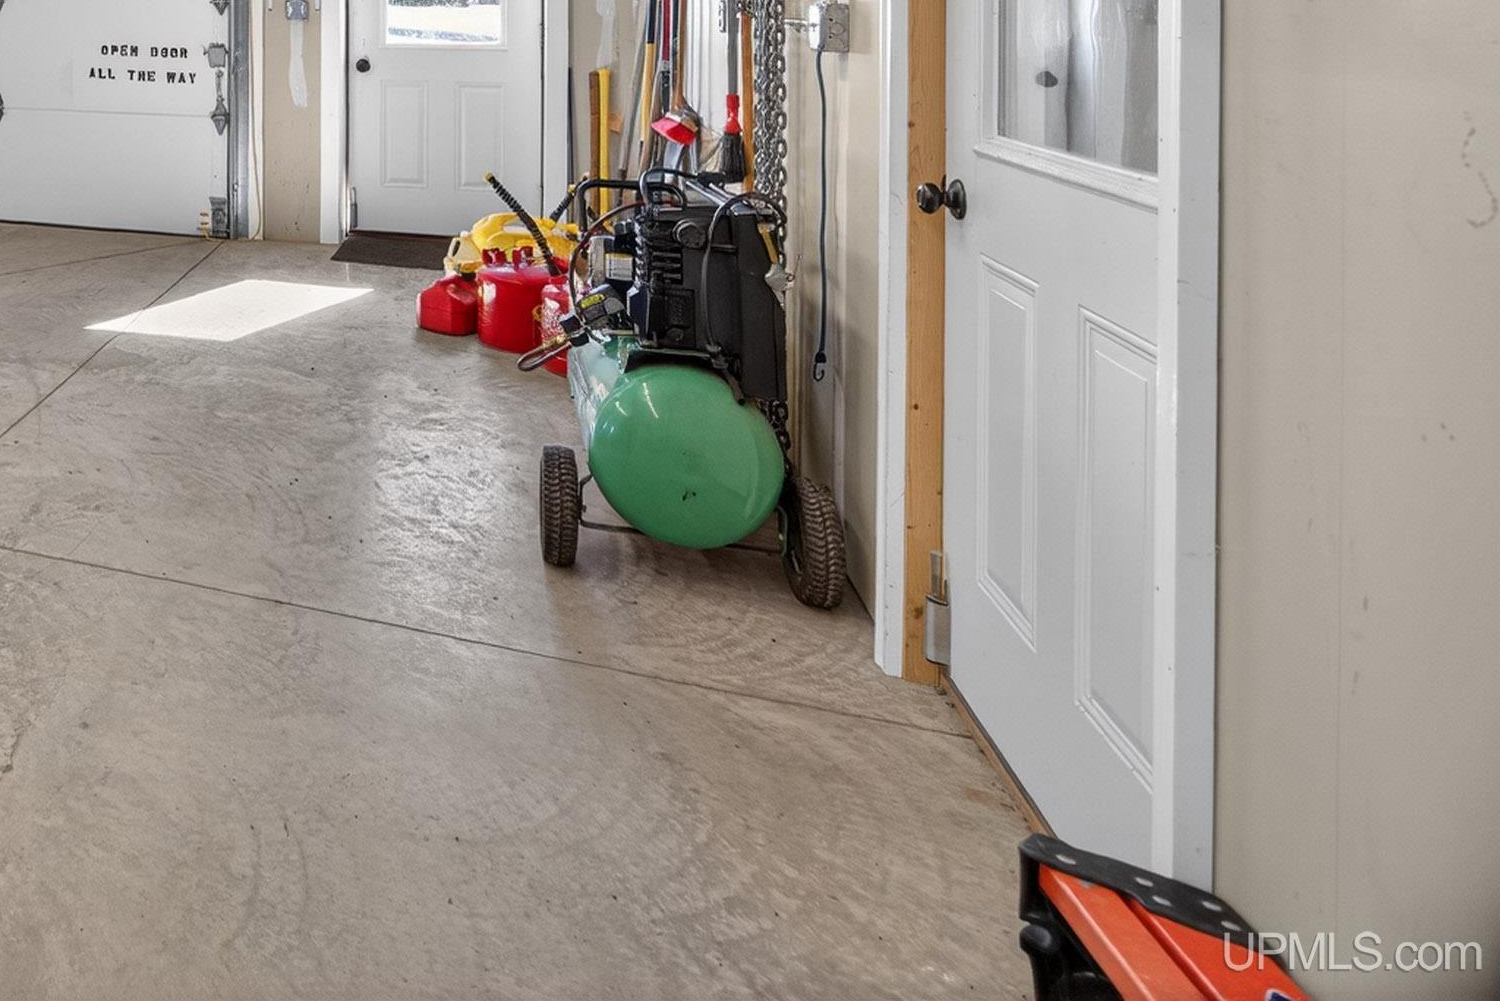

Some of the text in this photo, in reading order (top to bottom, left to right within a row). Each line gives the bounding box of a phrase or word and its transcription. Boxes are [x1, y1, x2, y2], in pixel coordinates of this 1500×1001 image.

[101, 44, 188, 59] OPEN DOOR
[89, 67, 196, 84] ALL THE WAY
